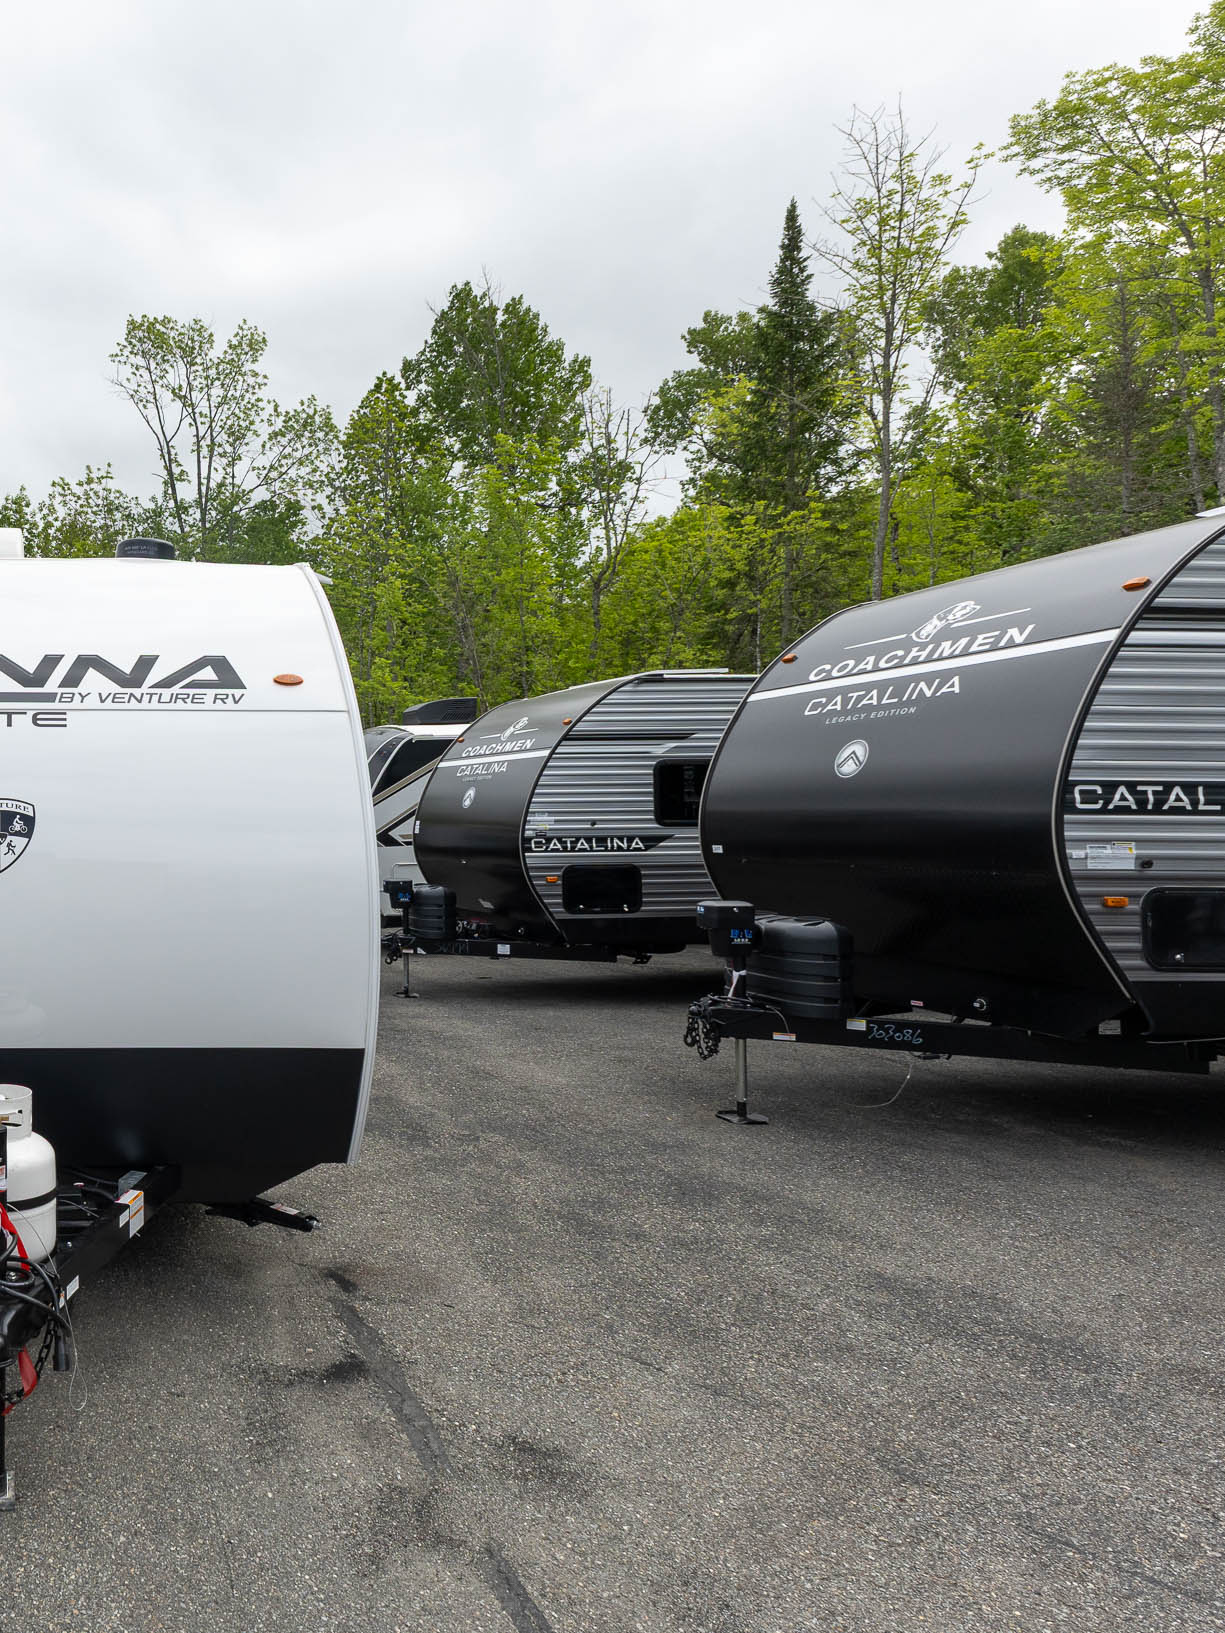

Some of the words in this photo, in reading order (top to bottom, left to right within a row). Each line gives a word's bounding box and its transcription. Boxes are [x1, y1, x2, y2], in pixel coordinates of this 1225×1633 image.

[808, 624, 1036, 682] COACHMEN
[58, 692, 91, 704] BY
[98, 692, 206, 704] VENTURE
[213, 693, 246, 705] RV
[804, 676, 961, 716] CATALINA
[826, 712, 868, 725] LEGACY
[870, 706, 917, 719] EDITION
[462, 739, 535, 757] COACHMEN
[456, 762, 508, 776] CATALINA
[1074, 785, 1221, 810] CATAL
[531, 837, 645, 851] CATALINA
